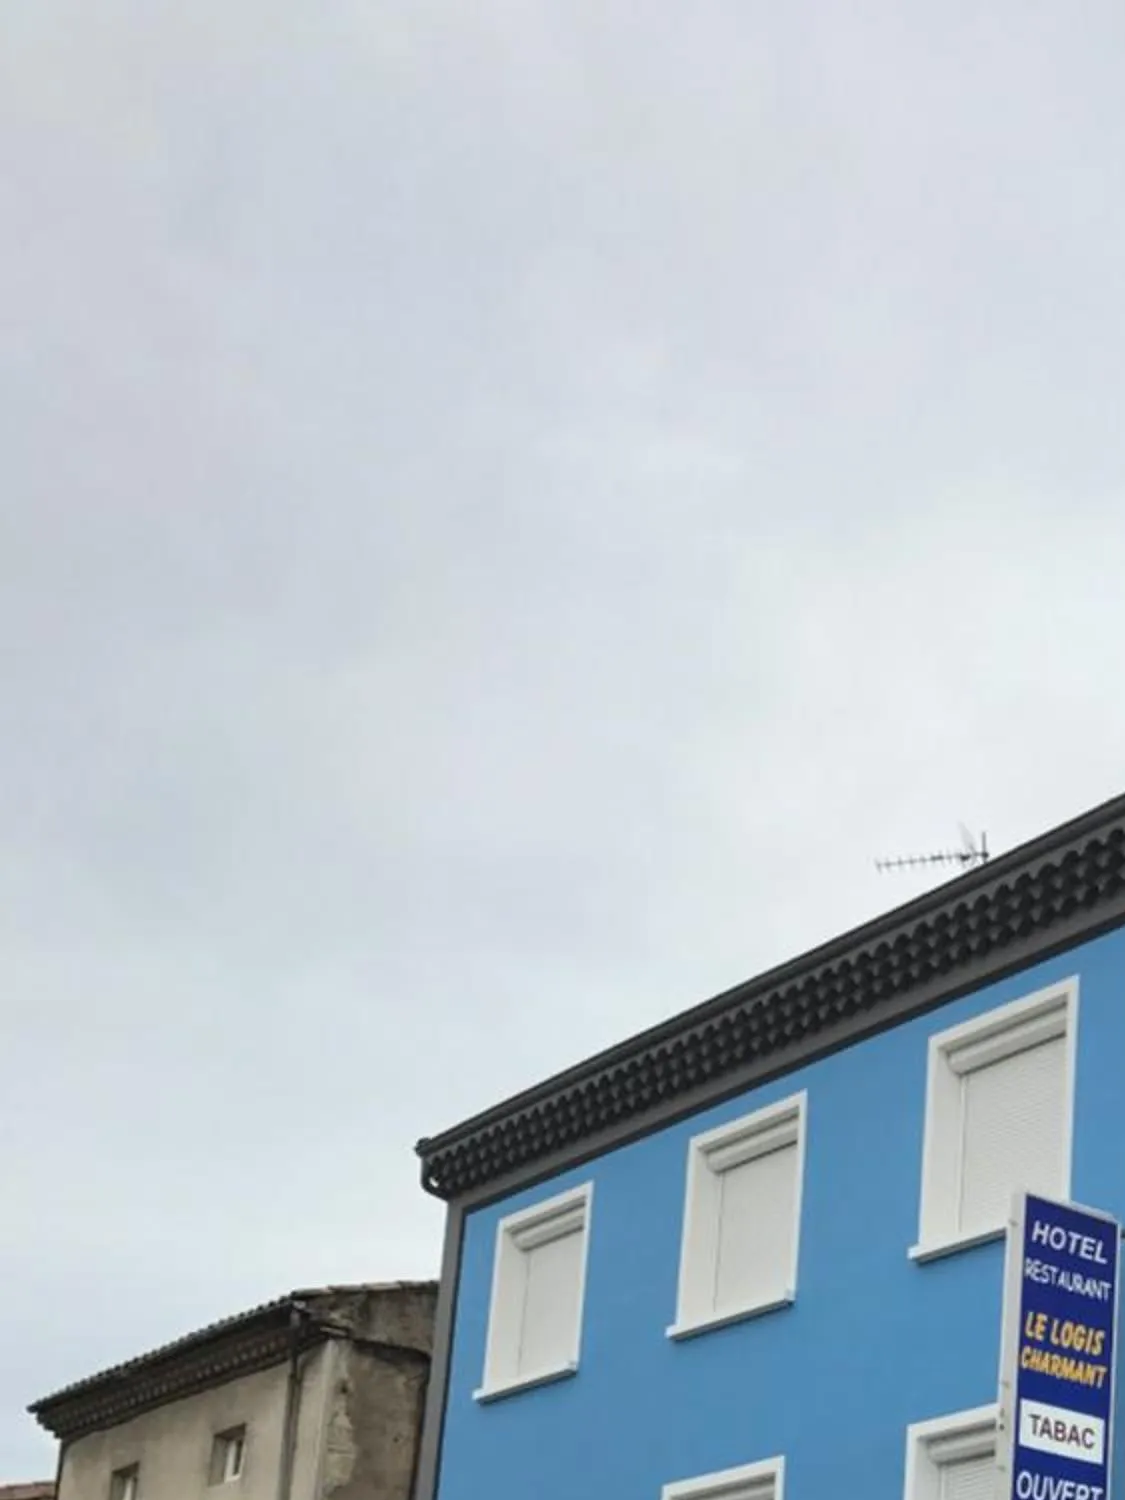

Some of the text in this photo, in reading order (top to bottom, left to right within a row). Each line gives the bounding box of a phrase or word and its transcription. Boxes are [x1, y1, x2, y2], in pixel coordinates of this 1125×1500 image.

[1031, 1219, 1108, 1265] HOTEL
[1024, 1256, 1112, 1302] RESTAURANT
[1025, 1311, 1106, 1357] LE LOGIS
[1020, 1344, 1108, 1389] CHARMANT
[1029, 1413, 1096, 1449] TABAC
